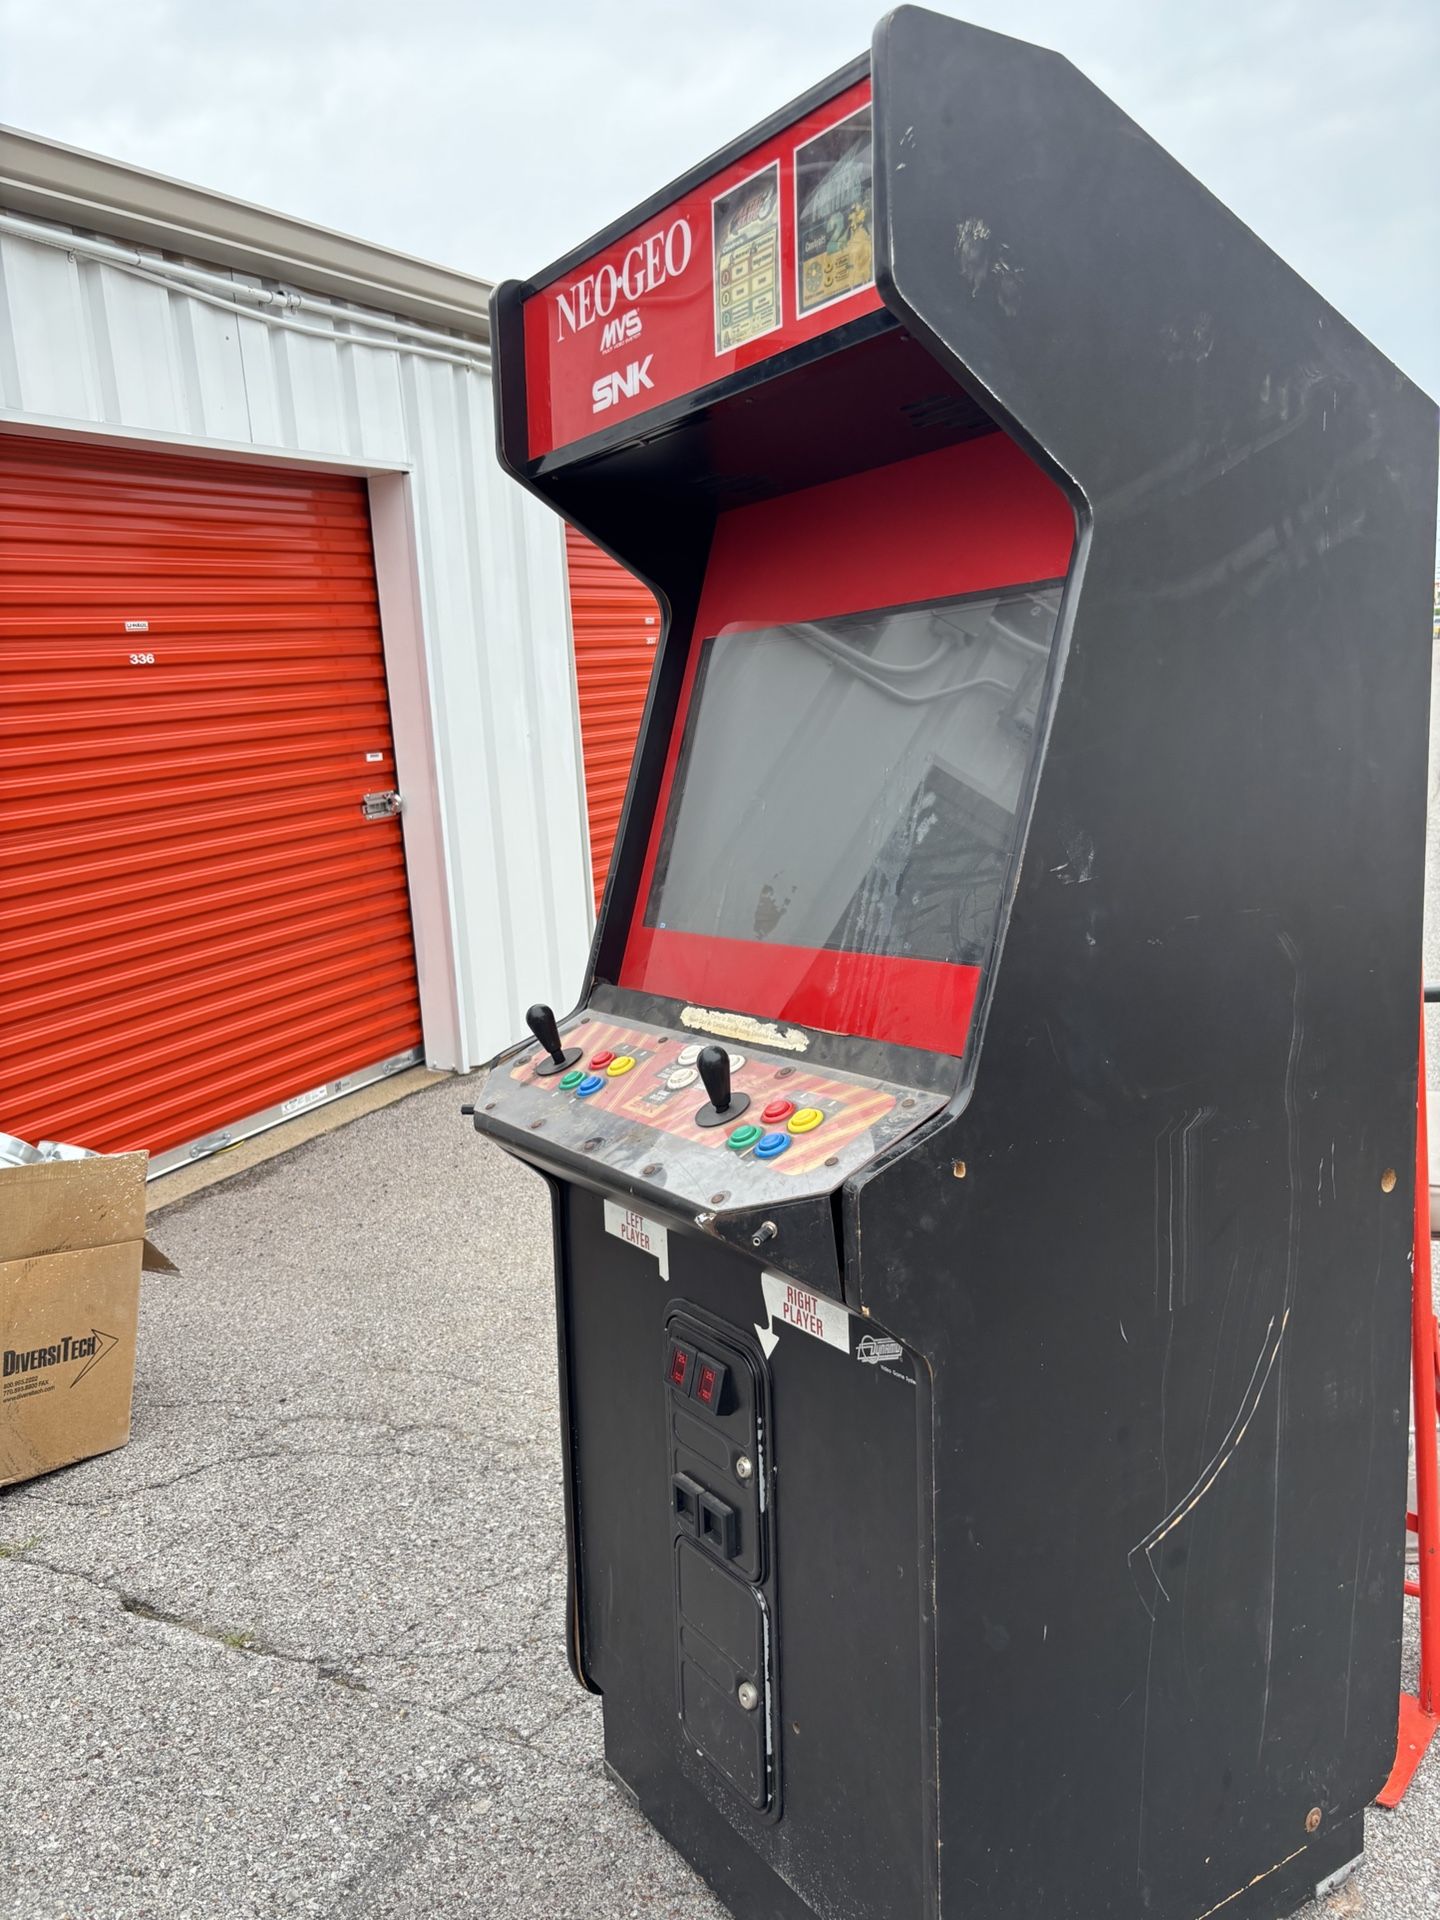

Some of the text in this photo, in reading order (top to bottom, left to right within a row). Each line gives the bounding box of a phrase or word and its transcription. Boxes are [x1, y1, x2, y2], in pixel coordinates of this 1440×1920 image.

[600, 308, 643, 352] MVS
[592, 353, 655, 414] SNK
[130, 653, 155, 665] 336
[625, 1210, 644, 1232] LEFT
[621, 1223, 650, 1251] PLAYER
[786, 1286, 818, 1316] RIGHT
[783, 1302, 824, 1337] PLAYER
